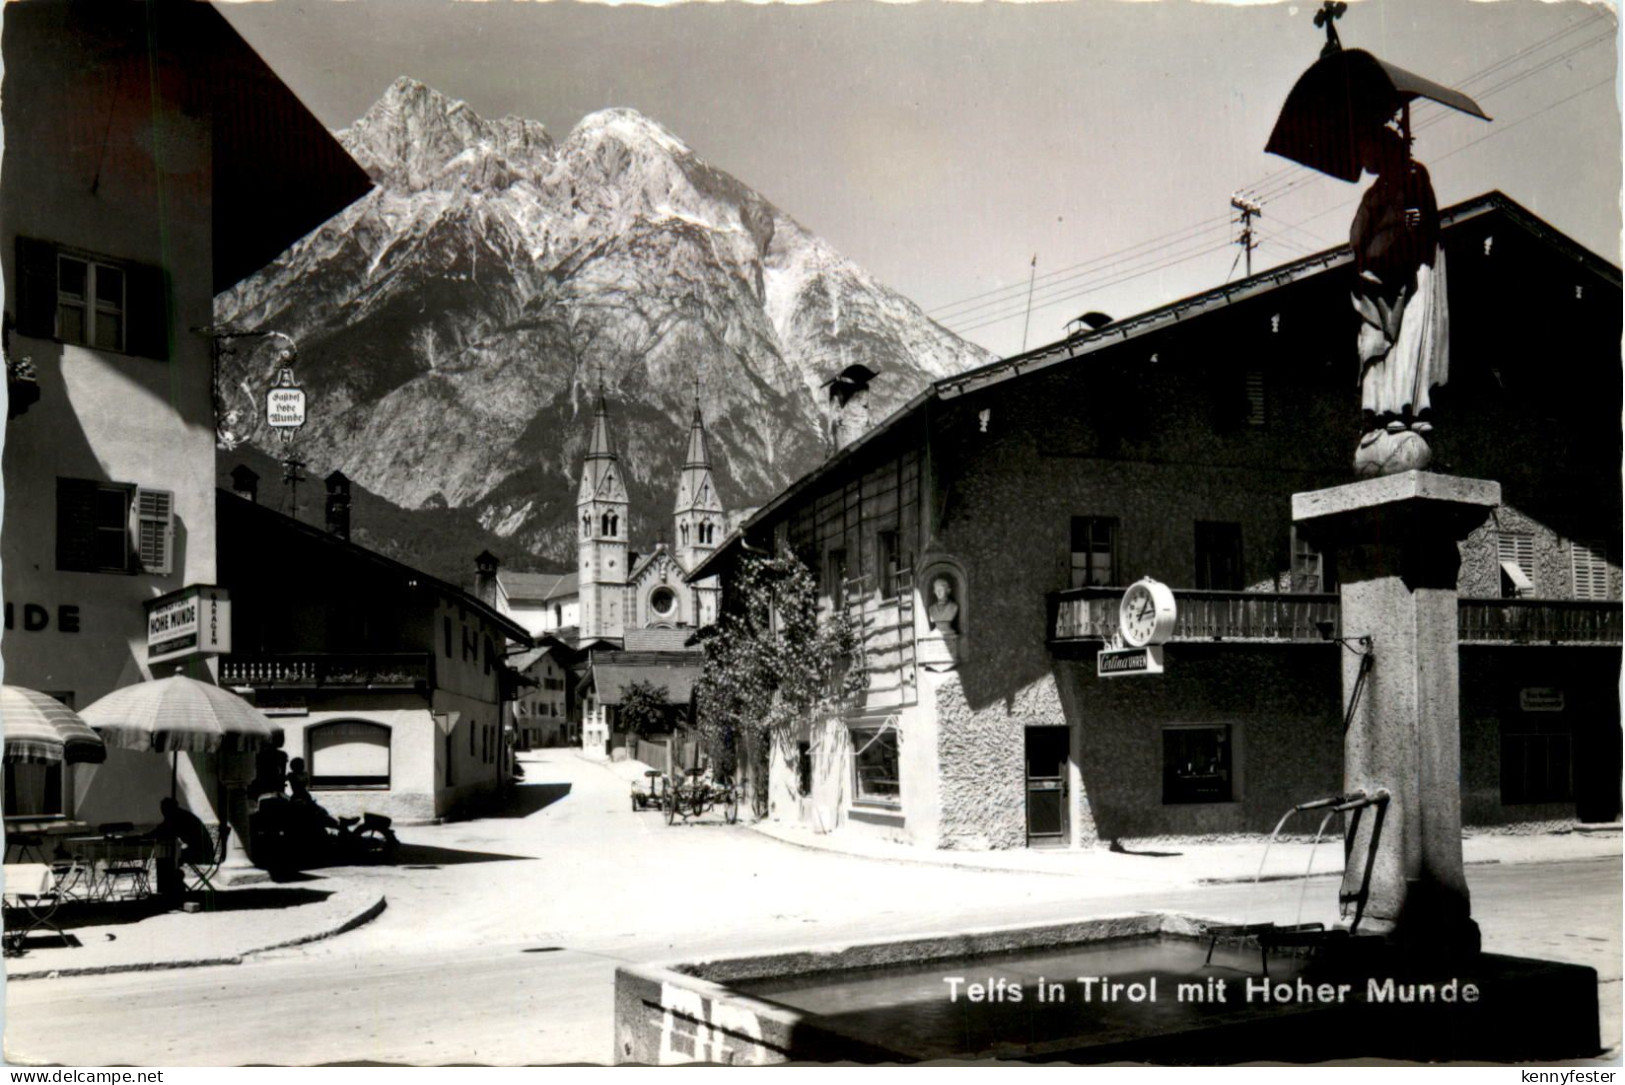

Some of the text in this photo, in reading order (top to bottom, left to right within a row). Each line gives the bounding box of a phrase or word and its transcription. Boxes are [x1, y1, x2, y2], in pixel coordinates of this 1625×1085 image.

[150, 613, 168, 635] HOHE
[171, 605, 195, 629] MUNDE
[210, 592, 218, 646] GARAGEN
[1129, 654, 1147, 668] UHREN
